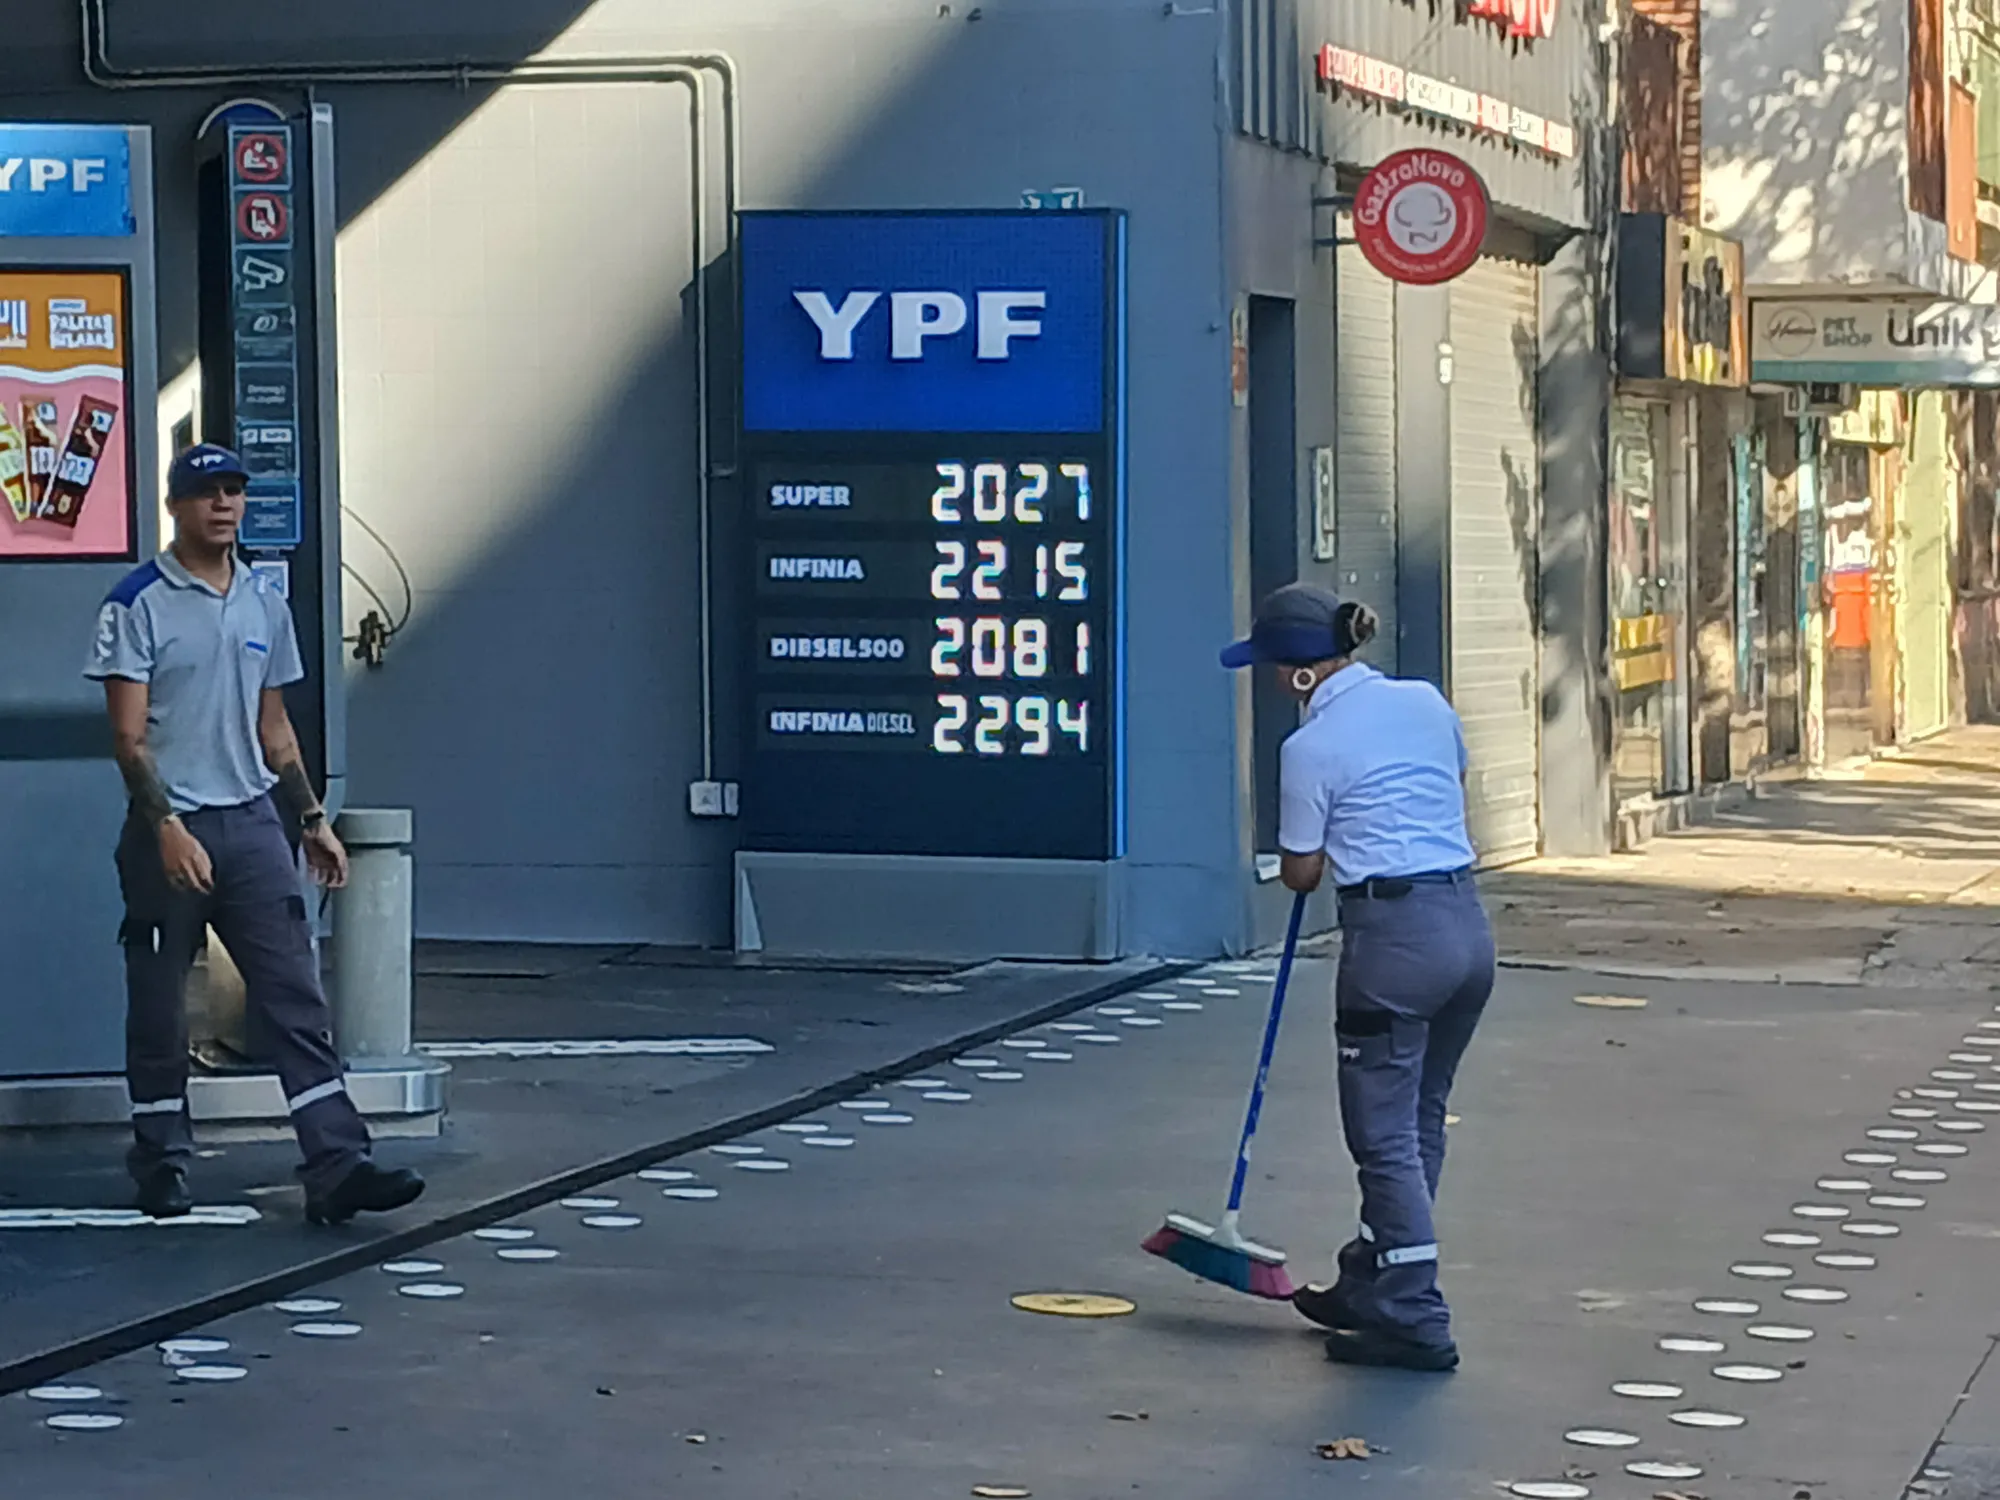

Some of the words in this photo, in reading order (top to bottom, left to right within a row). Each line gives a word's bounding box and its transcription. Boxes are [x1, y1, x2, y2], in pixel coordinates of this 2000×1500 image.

[1357, 153, 1466, 226] GastroNovo
[793, 291, 1046, 359] YPF
[771, 485, 851, 506] SUPER
[931, 463, 1089, 523] 2027
[770, 558, 865, 580] INFINIA
[931, 540, 1088, 600] 2215
[931, 617, 1089, 677] 2081
[770, 711, 865, 732] INFINIA
[867, 712, 917, 734] DIESEL
[931, 694, 1088, 755] 2294
